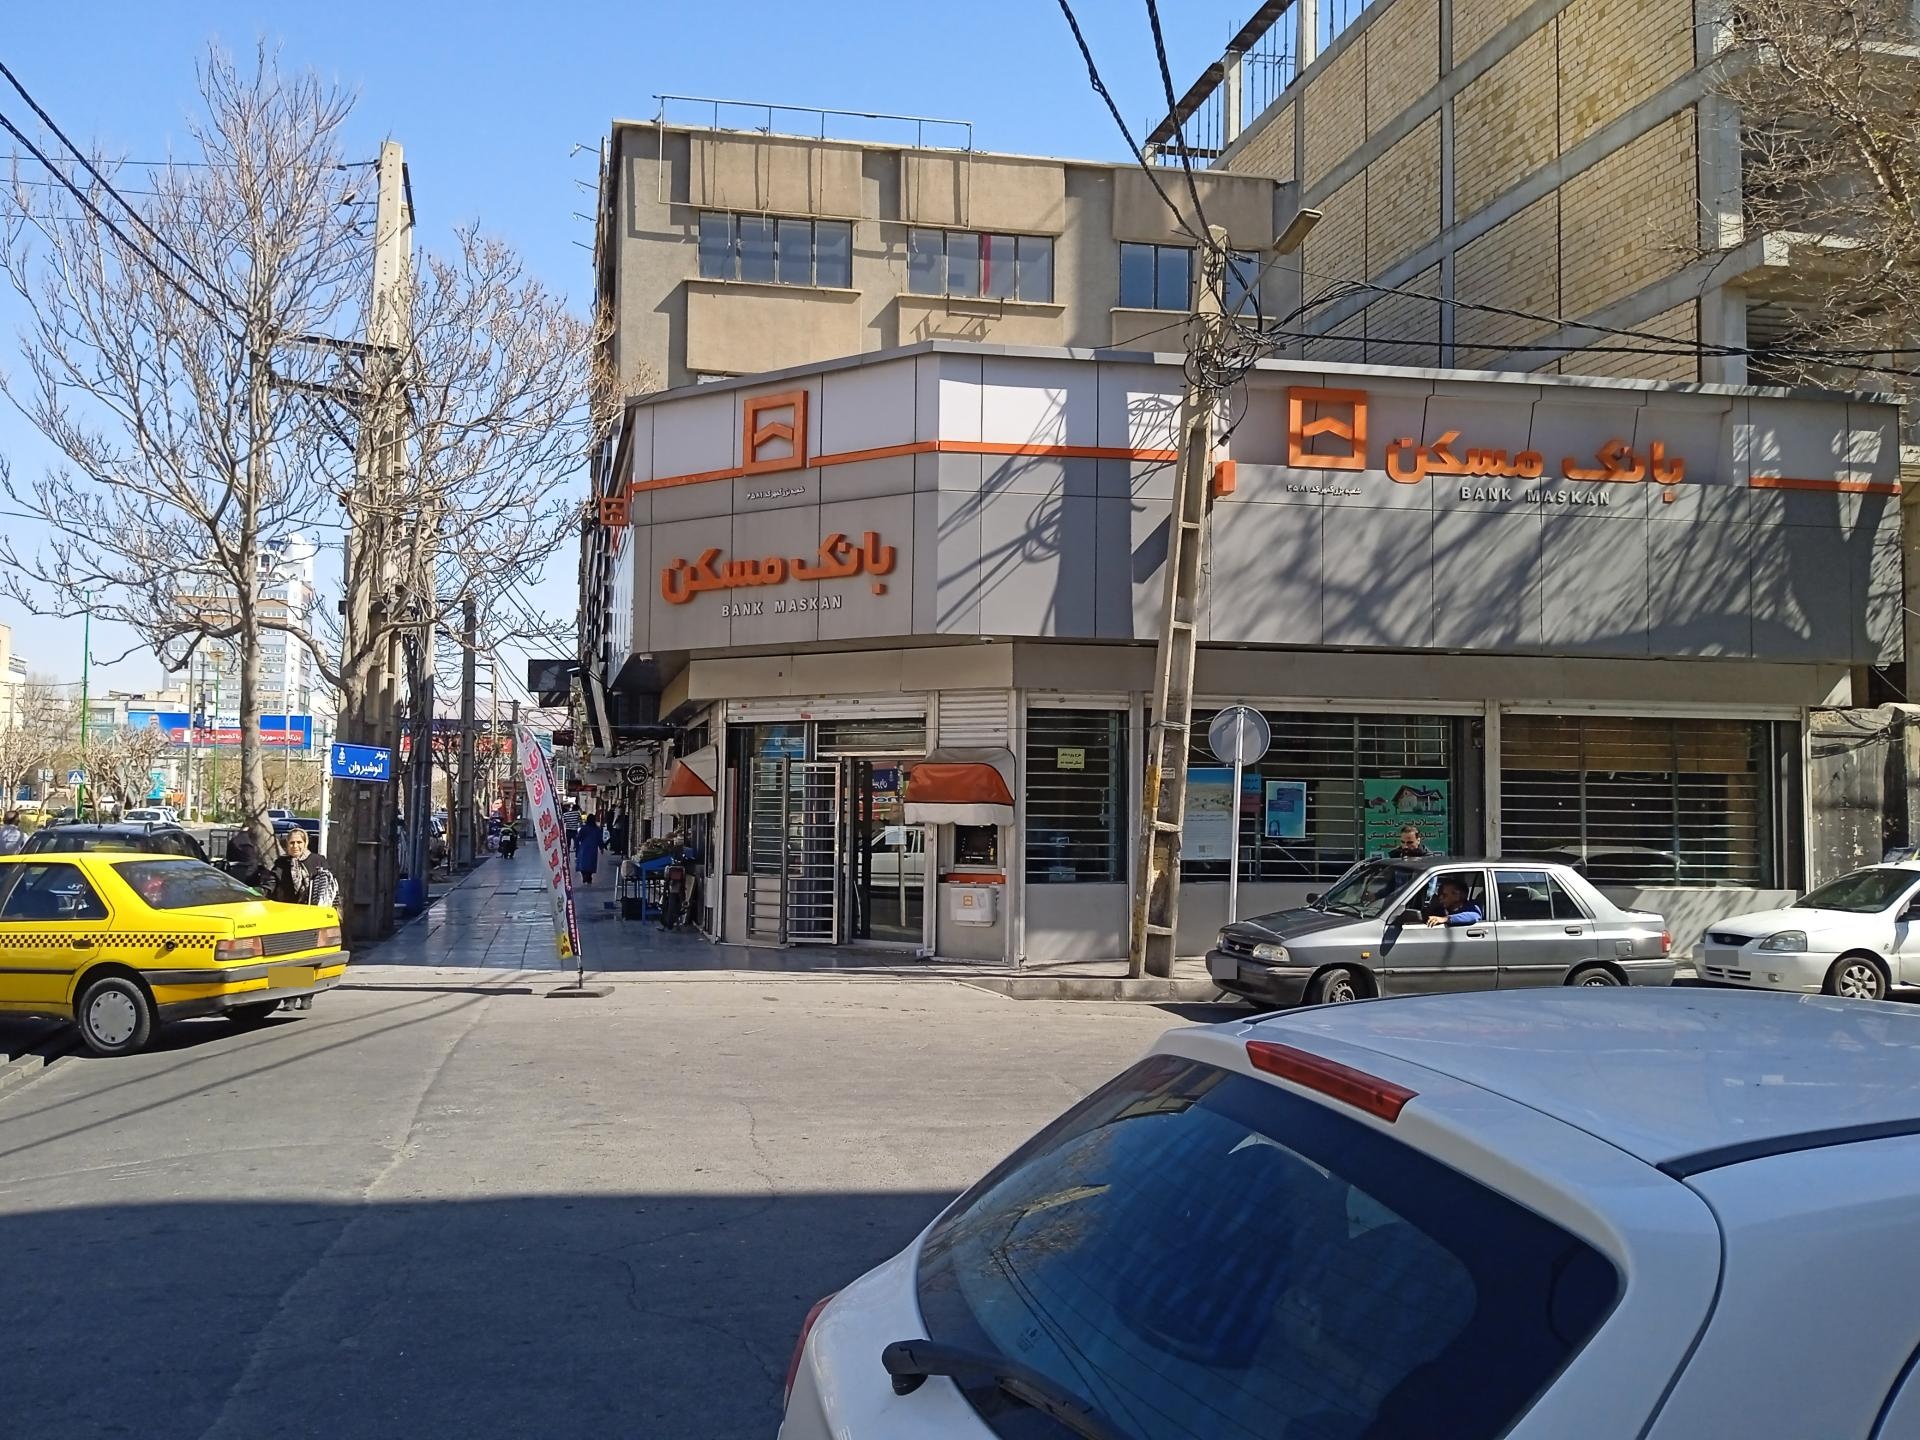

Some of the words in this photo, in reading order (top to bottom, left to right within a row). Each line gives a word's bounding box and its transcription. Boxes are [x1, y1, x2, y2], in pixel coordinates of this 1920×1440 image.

[1384, 430, 1543, 484] مسکن
[1562, 438, 1685, 504] بانک
[1460, 486, 1512, 501] BANK
[1526, 489, 1610, 506] MASKAN
[661, 547, 785, 604] مسکن
[790, 531, 896, 596] بانک
[721, 601, 764, 617] BANK
[775, 595, 842, 613] MASKAN
[348, 760, 383, 777] انوشیروان
[374, 750, 388, 760] بلوار
